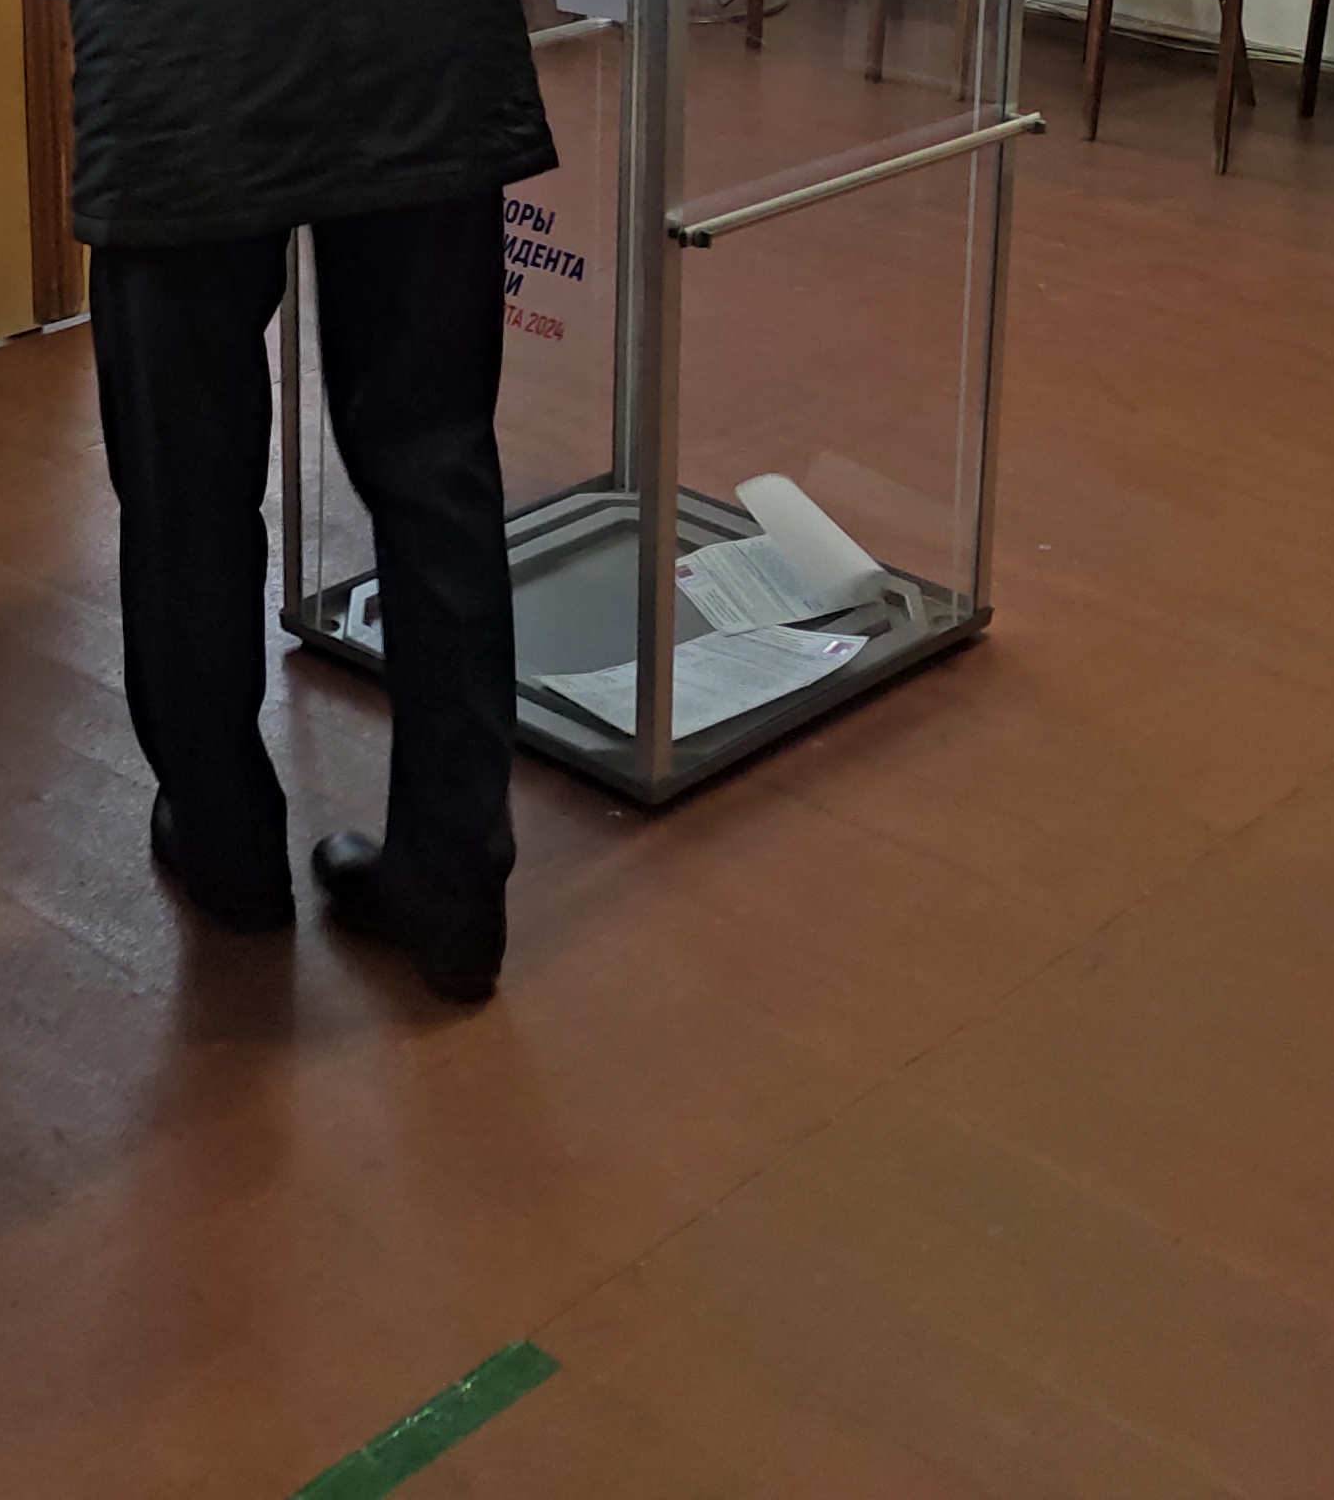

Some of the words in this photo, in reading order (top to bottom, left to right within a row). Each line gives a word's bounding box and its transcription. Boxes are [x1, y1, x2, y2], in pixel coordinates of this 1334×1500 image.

[503, 198, 556, 235] ОРЫ
[503, 234, 585, 282] ИДЕНТА
[525, 312, 565, 341] 2024
